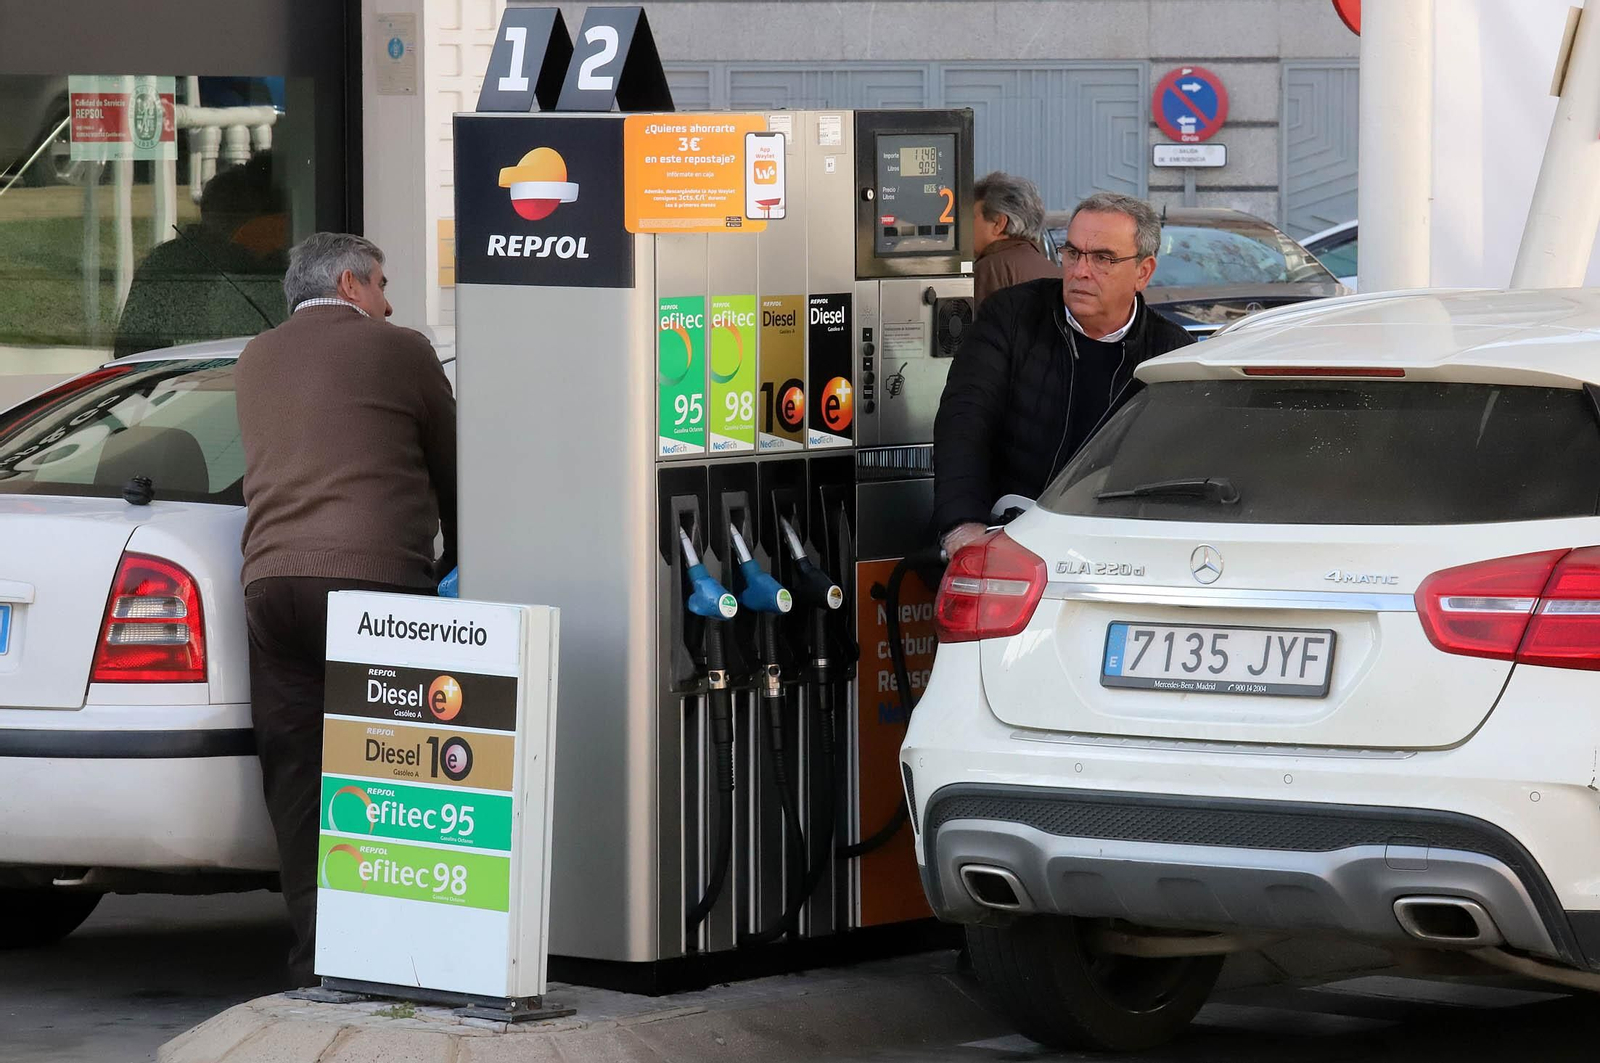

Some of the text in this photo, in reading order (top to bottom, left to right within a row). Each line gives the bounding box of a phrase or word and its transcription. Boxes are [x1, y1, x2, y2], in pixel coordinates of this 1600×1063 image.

[498, 27, 529, 91] 1
[577, 25, 619, 91] 2
[75, 109, 104, 119] REPSOL
[645, 123, 735, 134] ¿Quieres ahorrarte
[645, 154, 735, 165] en este repostaje?
[939, 187, 954, 223] 2
[487, 234, 590, 259] REPSOL
[661, 312, 703, 330] efitec
[713, 310, 754, 328] efitec
[763, 310, 796, 327] Diesel
[810, 306, 845, 325] Diesel
[674, 393, 703, 425] 95
[725, 391, 753, 422] 98
[663, 443, 687, 454] NeoTech
[713, 440, 737, 450] NeoTech
[760, 439, 784, 449] NeoTech
[809, 435, 833, 445] NeoTech
[1055, 560, 1145, 577] GLA 220d
[1323, 569, 1400, 585] 4MATIC
[357, 611, 488, 647] Autoservicio
[1109, 656, 1118, 668] E
[1129, 630, 1326, 678] 7135 JYF
[368, 668, 397, 678] REPSOL
[367, 679, 423, 707] Diesel
[1153, 680, 1194, 690] Mercedes-Benz
[1195, 682, 1216, 690] Madrid
[1235, 684, 1246, 692] 900
[1253, 685, 1267, 693] 2004
[393, 709, 416, 718] Gasóleo
[366, 727, 395, 737] REPSOL
[365, 738, 420, 766] Diesel
[426, 736, 473, 782] 10
[393, 768, 414, 777] Gasóleo
[367, 787, 395, 797] REPSOL
[366, 800, 475, 836] efitec 95
[359, 845, 388, 855] REPSOL
[359, 859, 468, 895] efitec 98
